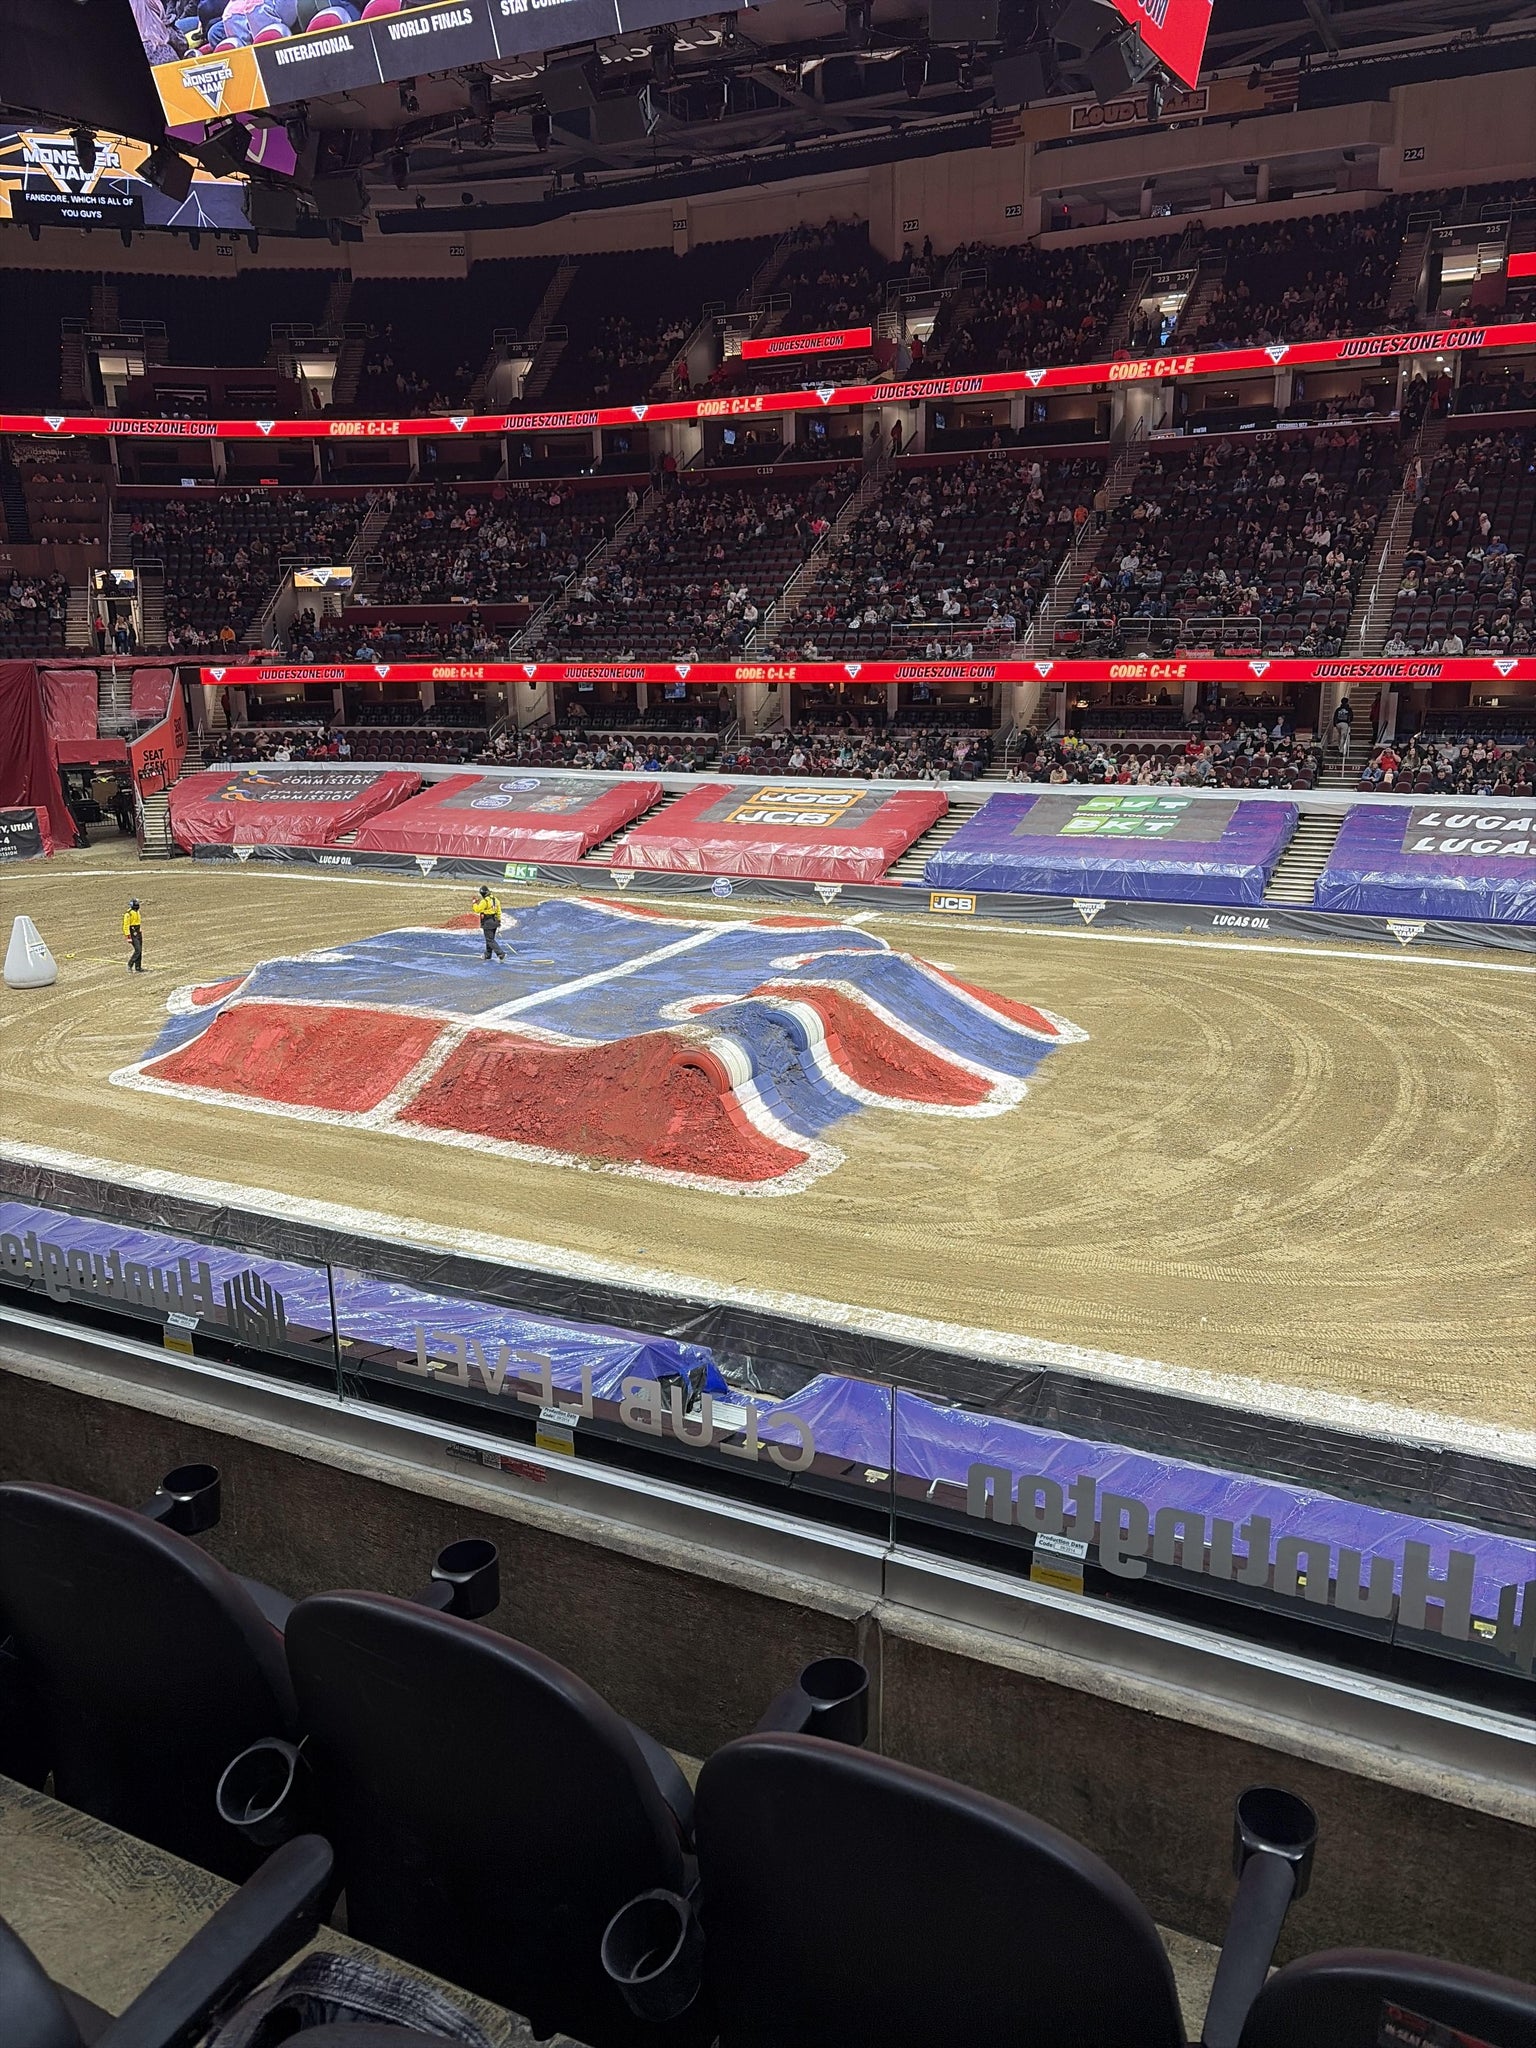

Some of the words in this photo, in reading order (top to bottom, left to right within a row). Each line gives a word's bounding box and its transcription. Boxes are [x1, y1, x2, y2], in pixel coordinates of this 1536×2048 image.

[501, 0, 528, 15] STAY
[388, 18, 430, 41] WORLD
[432, 8, 473, 32] FINALS
[275, 35, 354, 66] INTERATIONAL
[182, 69, 233, 88] MONSTER
[197, 80, 223, 94] JAM
[23, 147, 120, 168] MONSER
[1404, 148, 1424, 160] 224
[25, 193, 69, 203] FANSCORE,
[70, 195, 97, 204] WHICH
[98, 196, 106, 204] IS
[107, 196, 121, 205] ALL
[123, 198, 133, 206] OF
[61, 208, 79, 217] YOU
[80, 209, 102, 218] GUYS
[1006, 206, 1022, 216] 223
[673, 220, 687, 229] 221
[903, 221, 918, 231] 222
[1440, 230, 1453, 238] 224
[218, 247, 232, 255] 219
[450, 247, 465, 255] 220
[1177, 273, 1189, 281] 224
[767, 335, 844, 353] JUDGESZONE.COM
[1337, 330, 1486, 359] JUDGESZONE.COM
[1109, 362, 1151, 380] CODE:
[1154, 357, 1195, 376] C-L-E
[872, 378, 983, 400] JUDGESZONE.COM
[697, 401, 730, 416] CODE:
[732, 398, 763, 413] C-L-E
[503, 412, 599, 428] JUDGESZONE.COM
[105, 421, 218, 435] JUDGESZONE.COM
[330, 422, 365, 435] CODE:
[367, 422, 400, 435] C-L-E
[257, 668, 345, 680] JUDGESZONE.COM
[432, 667, 459, 678] CODE:
[460, 667, 484, 678] C-L-E
[564, 667, 645, 679] JUDGESZONE.COM
[735, 667, 765, 680] CODE:
[767, 666, 797, 679] C-L-E
[895, 666, 996, 679] JUDGESZONE.COM
[1109, 664, 1147, 678] CODE:
[1150, 664, 1187, 678] C-L-E
[1311, 663, 1443, 678] JUDGESZONE.COM
[143, 748, 164, 761] SEAT
[281, 777, 372, 785] COMMISSION
[760, 793, 854, 804] JCB
[736, 811, 831, 824] JCB
[1417, 813, 1536, 832] LUCA
[10, 822, 33, 832] UTAH
[1067, 819, 1175, 831] BKT
[319, 855, 339, 864] LUCAS
[340, 857, 352, 865] OIL
[505, 864, 537, 878] BKT
[933, 898, 972, 910] JCB
[1073, 902, 1106, 910] MONSTER
[1213, 915, 1250, 927] LUCAS
[1251, 917, 1270, 928] OIL
[1386, 923, 1425, 933] MONSTER
[1040, 1534, 1070, 1546] Production
[1071, 1541, 1084, 1549] Date
